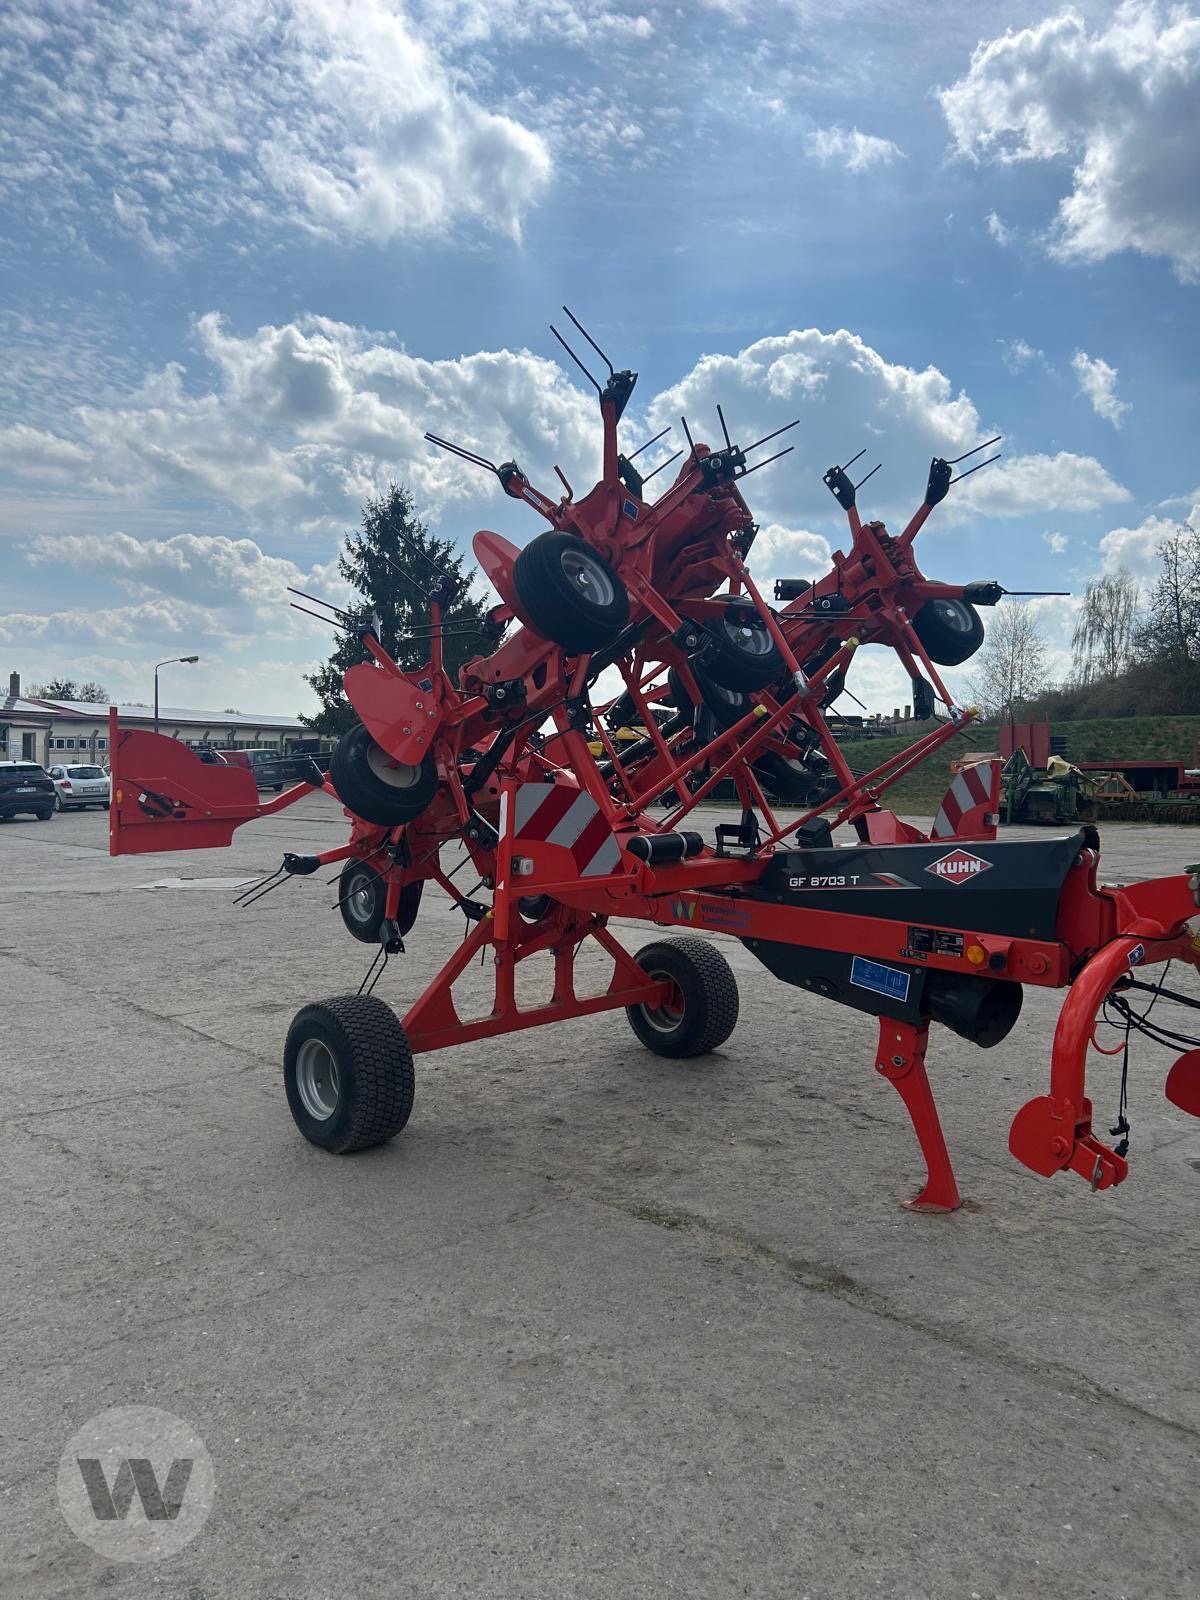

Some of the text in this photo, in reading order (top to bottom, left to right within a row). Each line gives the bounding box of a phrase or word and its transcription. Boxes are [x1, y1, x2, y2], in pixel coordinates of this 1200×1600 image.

[936, 860, 981, 875] KUHN
[789, 875, 860, 887] GF 8703 T
